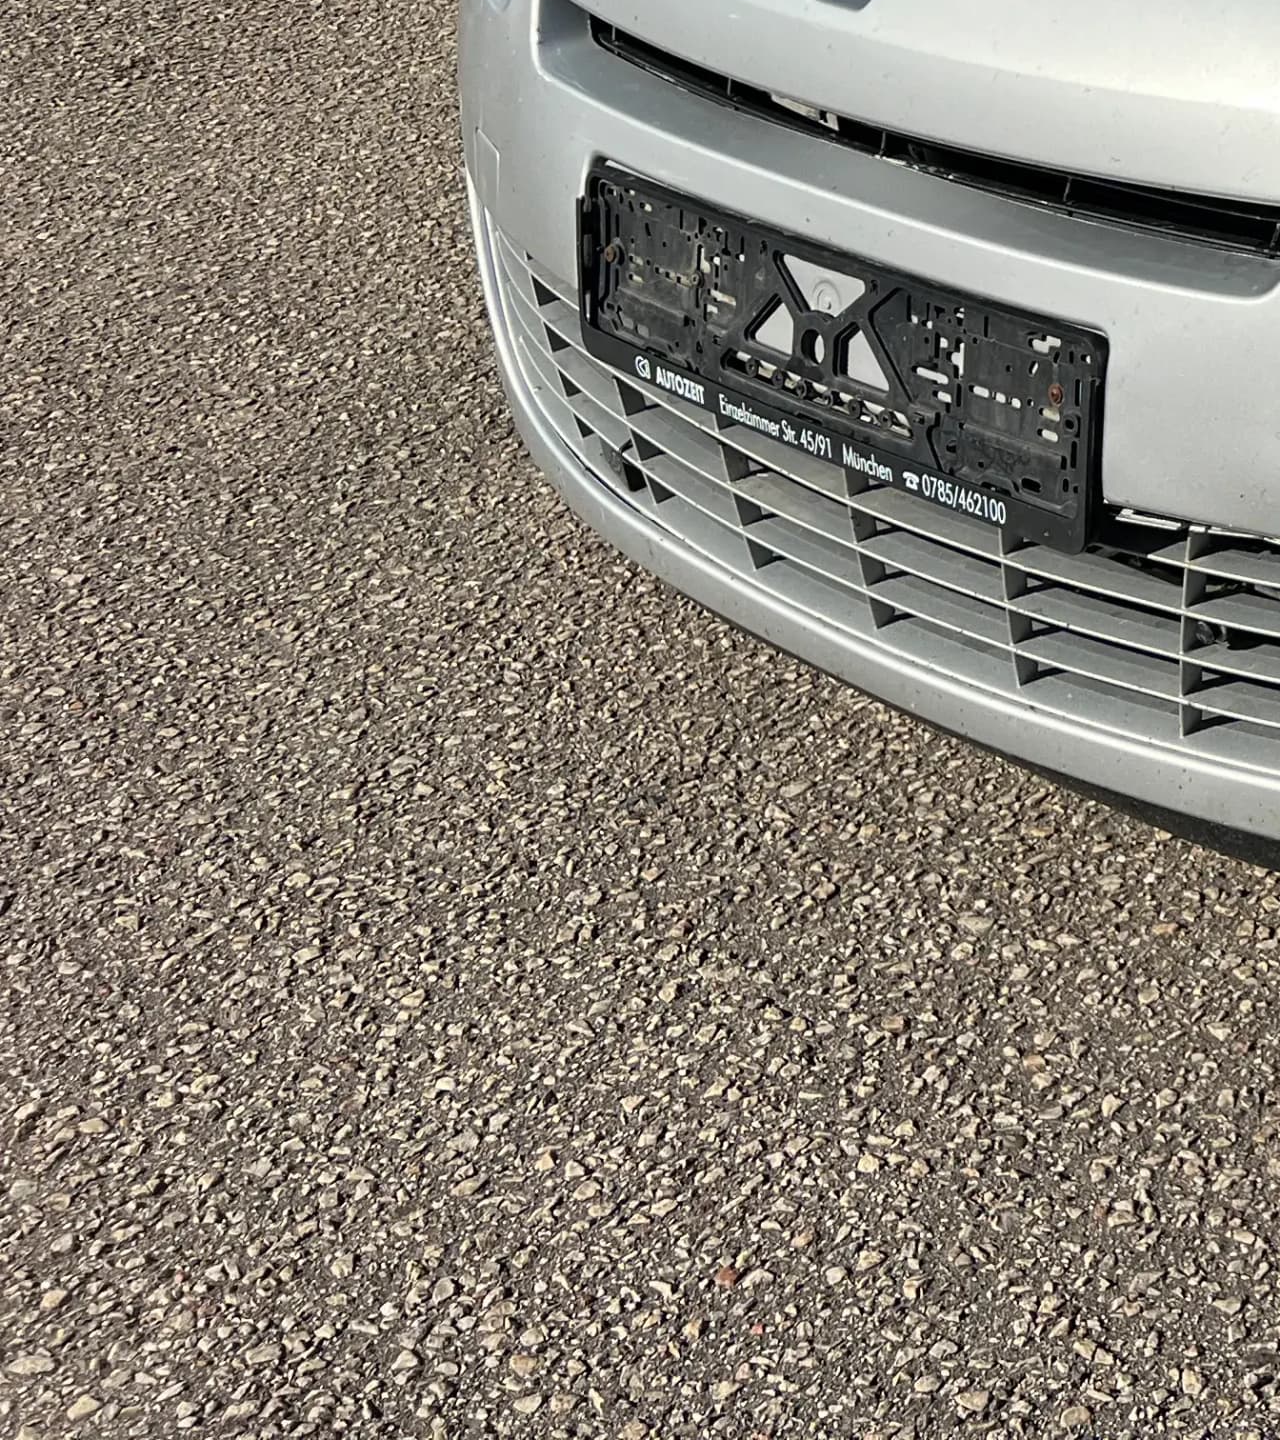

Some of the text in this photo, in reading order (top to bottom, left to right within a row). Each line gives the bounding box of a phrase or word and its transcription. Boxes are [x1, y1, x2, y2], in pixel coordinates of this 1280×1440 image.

[656, 366, 1007, 524] AUTOZEIT Einzelzimmer Str. 45/91 München 0785/462100
